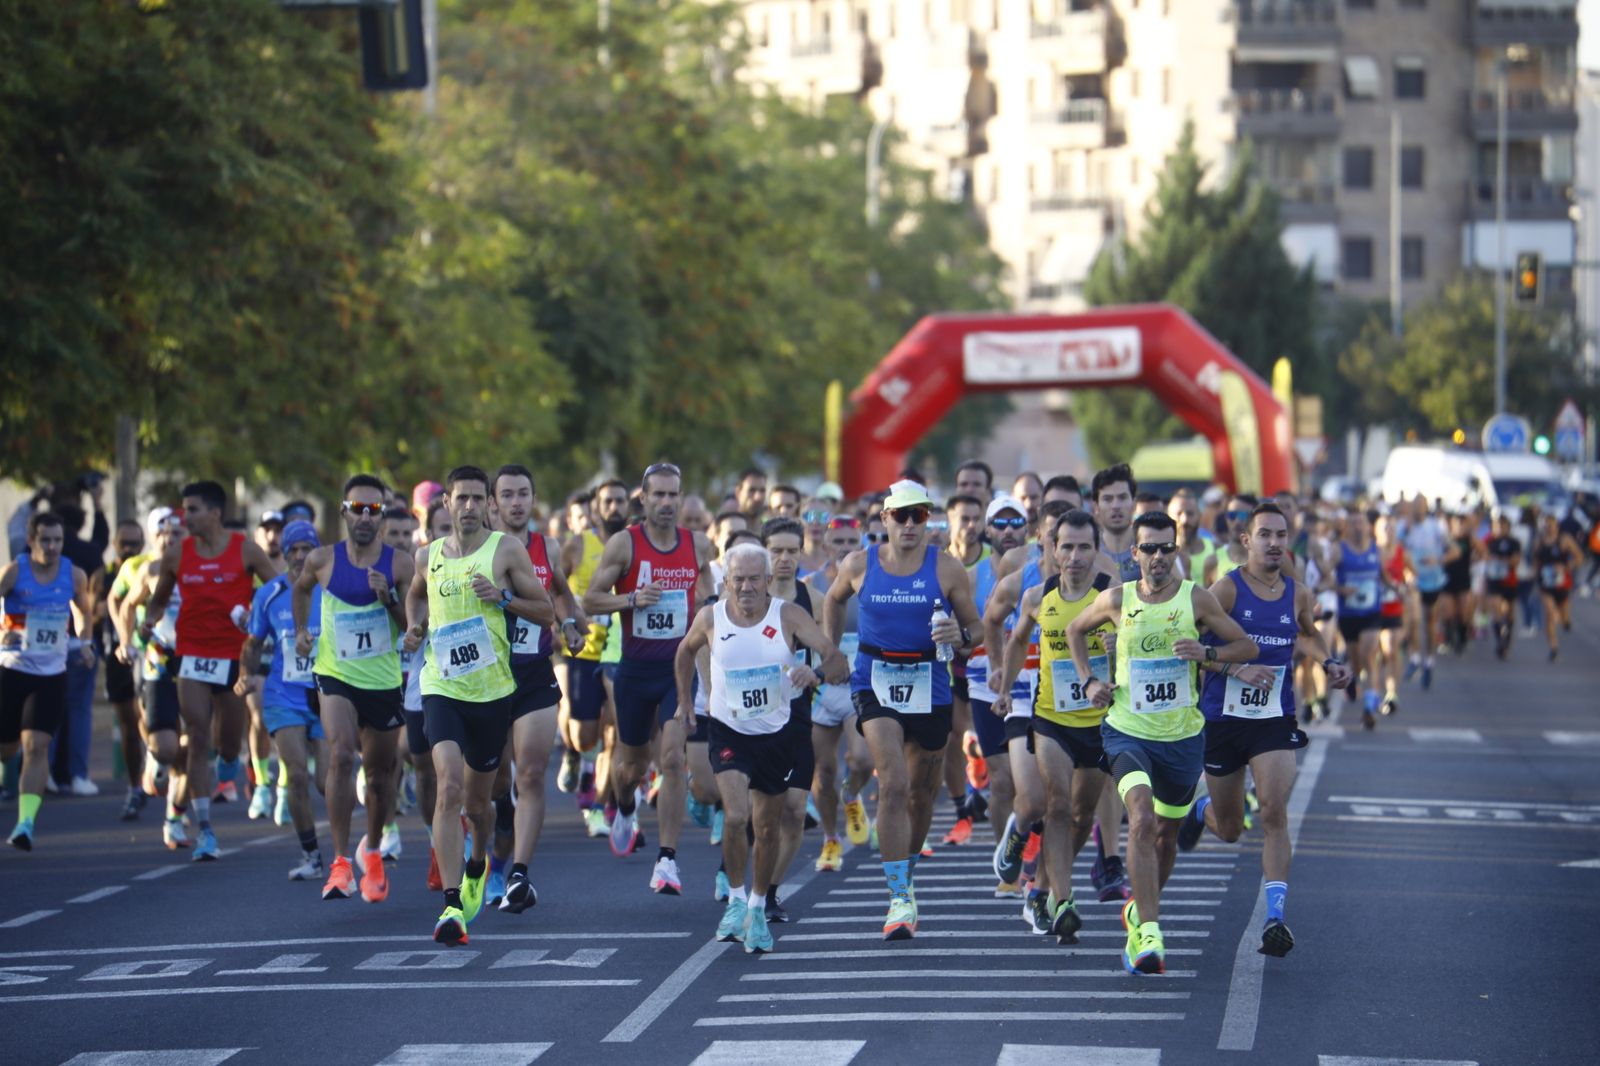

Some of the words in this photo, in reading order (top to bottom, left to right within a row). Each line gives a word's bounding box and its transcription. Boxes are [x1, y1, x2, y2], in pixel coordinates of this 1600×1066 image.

[871, 595, 928, 603] TROTASIERRA
[647, 613, 674, 630] 534
[355, 632, 372, 650] 71
[449, 643, 480, 666] 488
[742, 688, 768, 708] 581
[888, 685, 914, 703] 157
[1145, 682, 1177, 702] 348
[1240, 687, 1269, 706] 548
